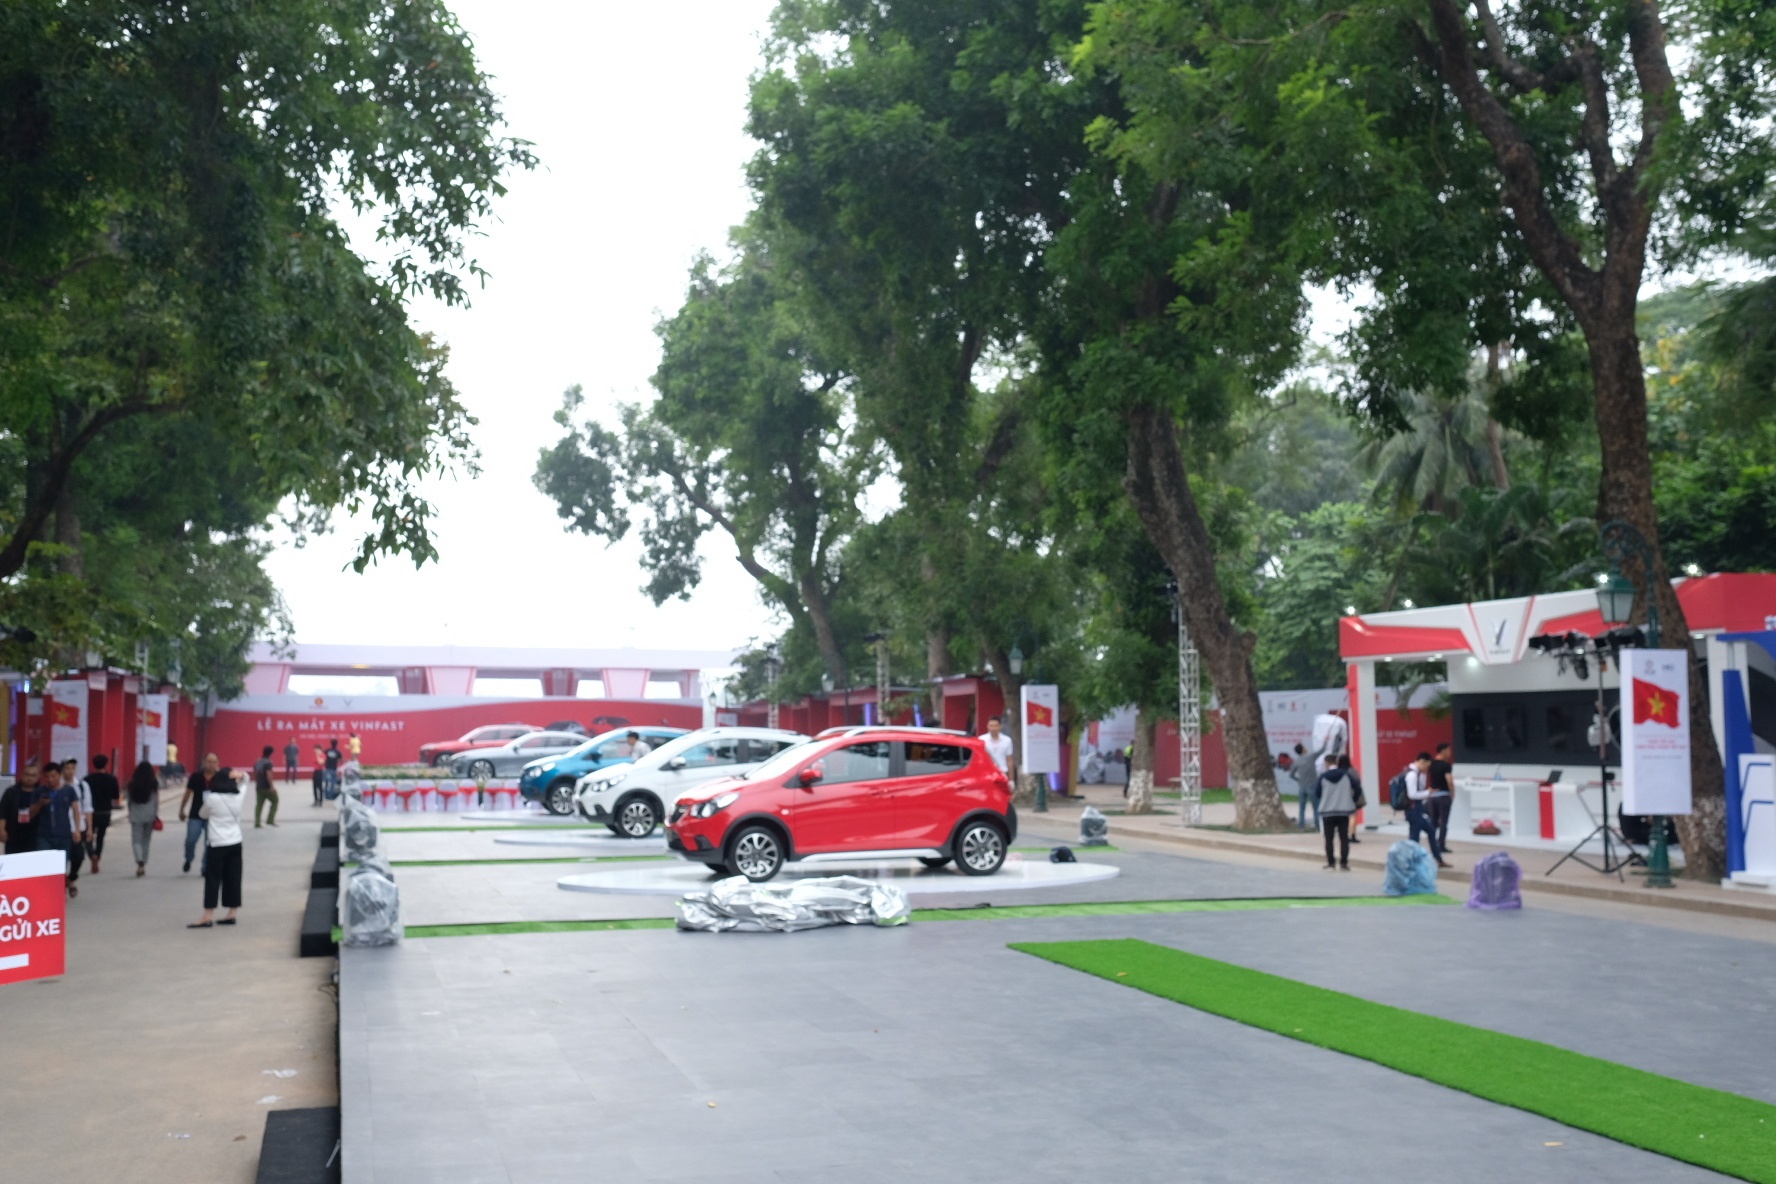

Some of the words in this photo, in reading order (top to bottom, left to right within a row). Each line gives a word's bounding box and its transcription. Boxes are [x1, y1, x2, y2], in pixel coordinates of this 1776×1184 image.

[277, 720, 294, 731] RA
[330, 720, 346, 731] XE
[350, 720, 405, 731] VINFAST
[36, 918, 61, 937] XE
